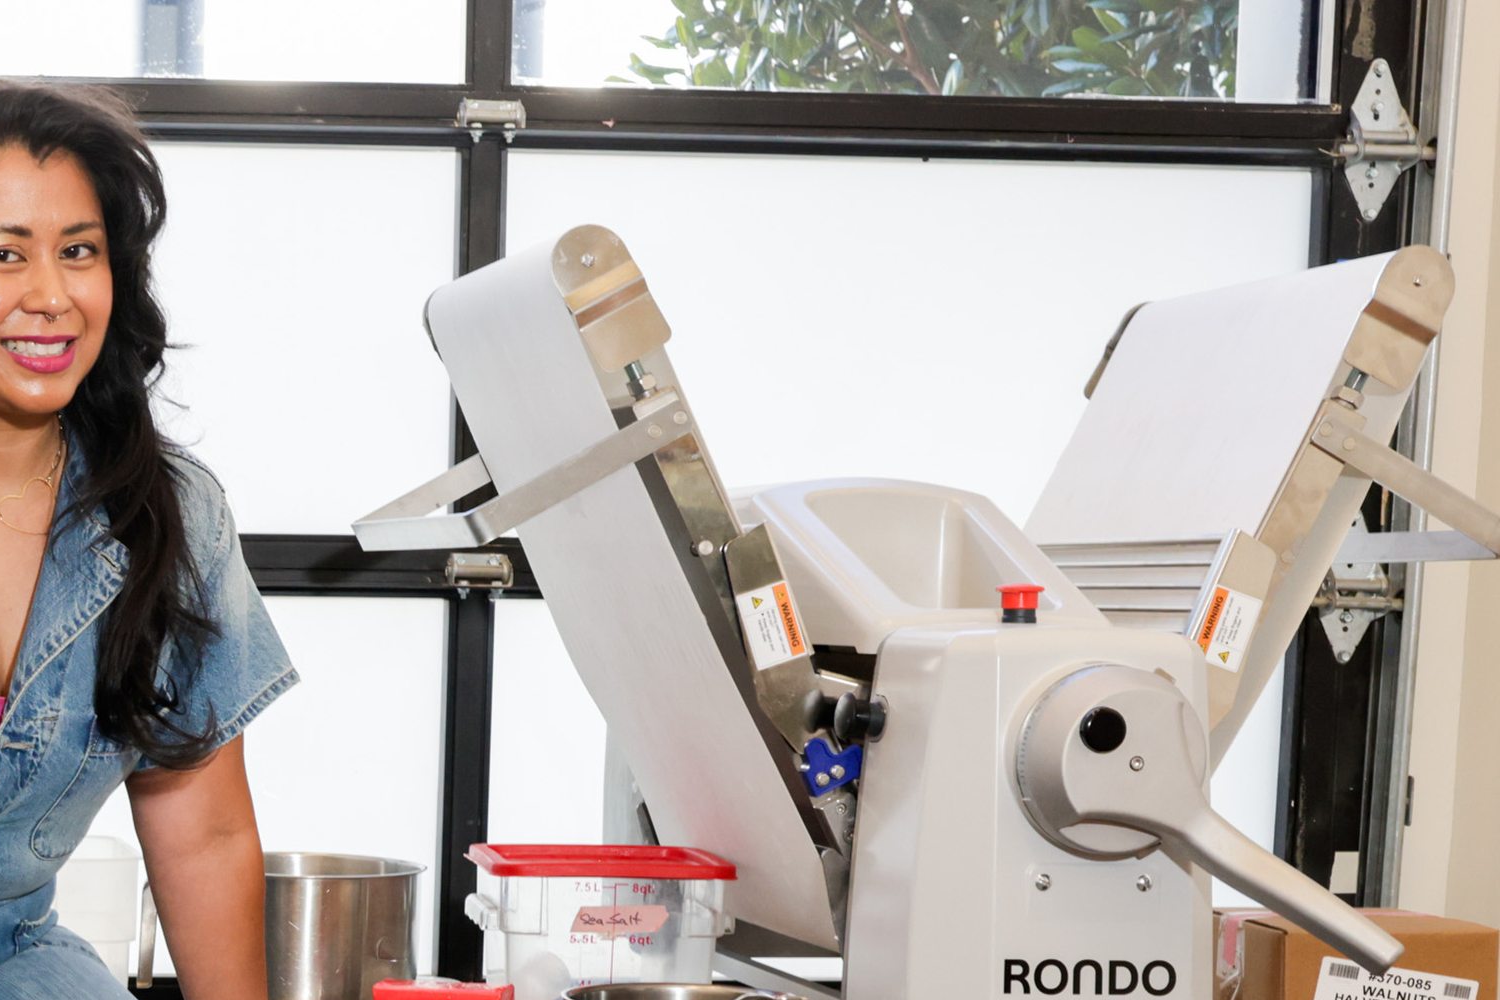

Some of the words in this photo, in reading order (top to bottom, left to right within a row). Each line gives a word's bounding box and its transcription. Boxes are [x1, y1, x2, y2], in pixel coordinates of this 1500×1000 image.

[780, 602, 800, 647] WARNING
[1202, 595, 1224, 640] WARNING
[580, 913, 604, 926] Sea
[605, 911, 643, 926] Salt
[1003, 958, 1177, 996] RONDO
